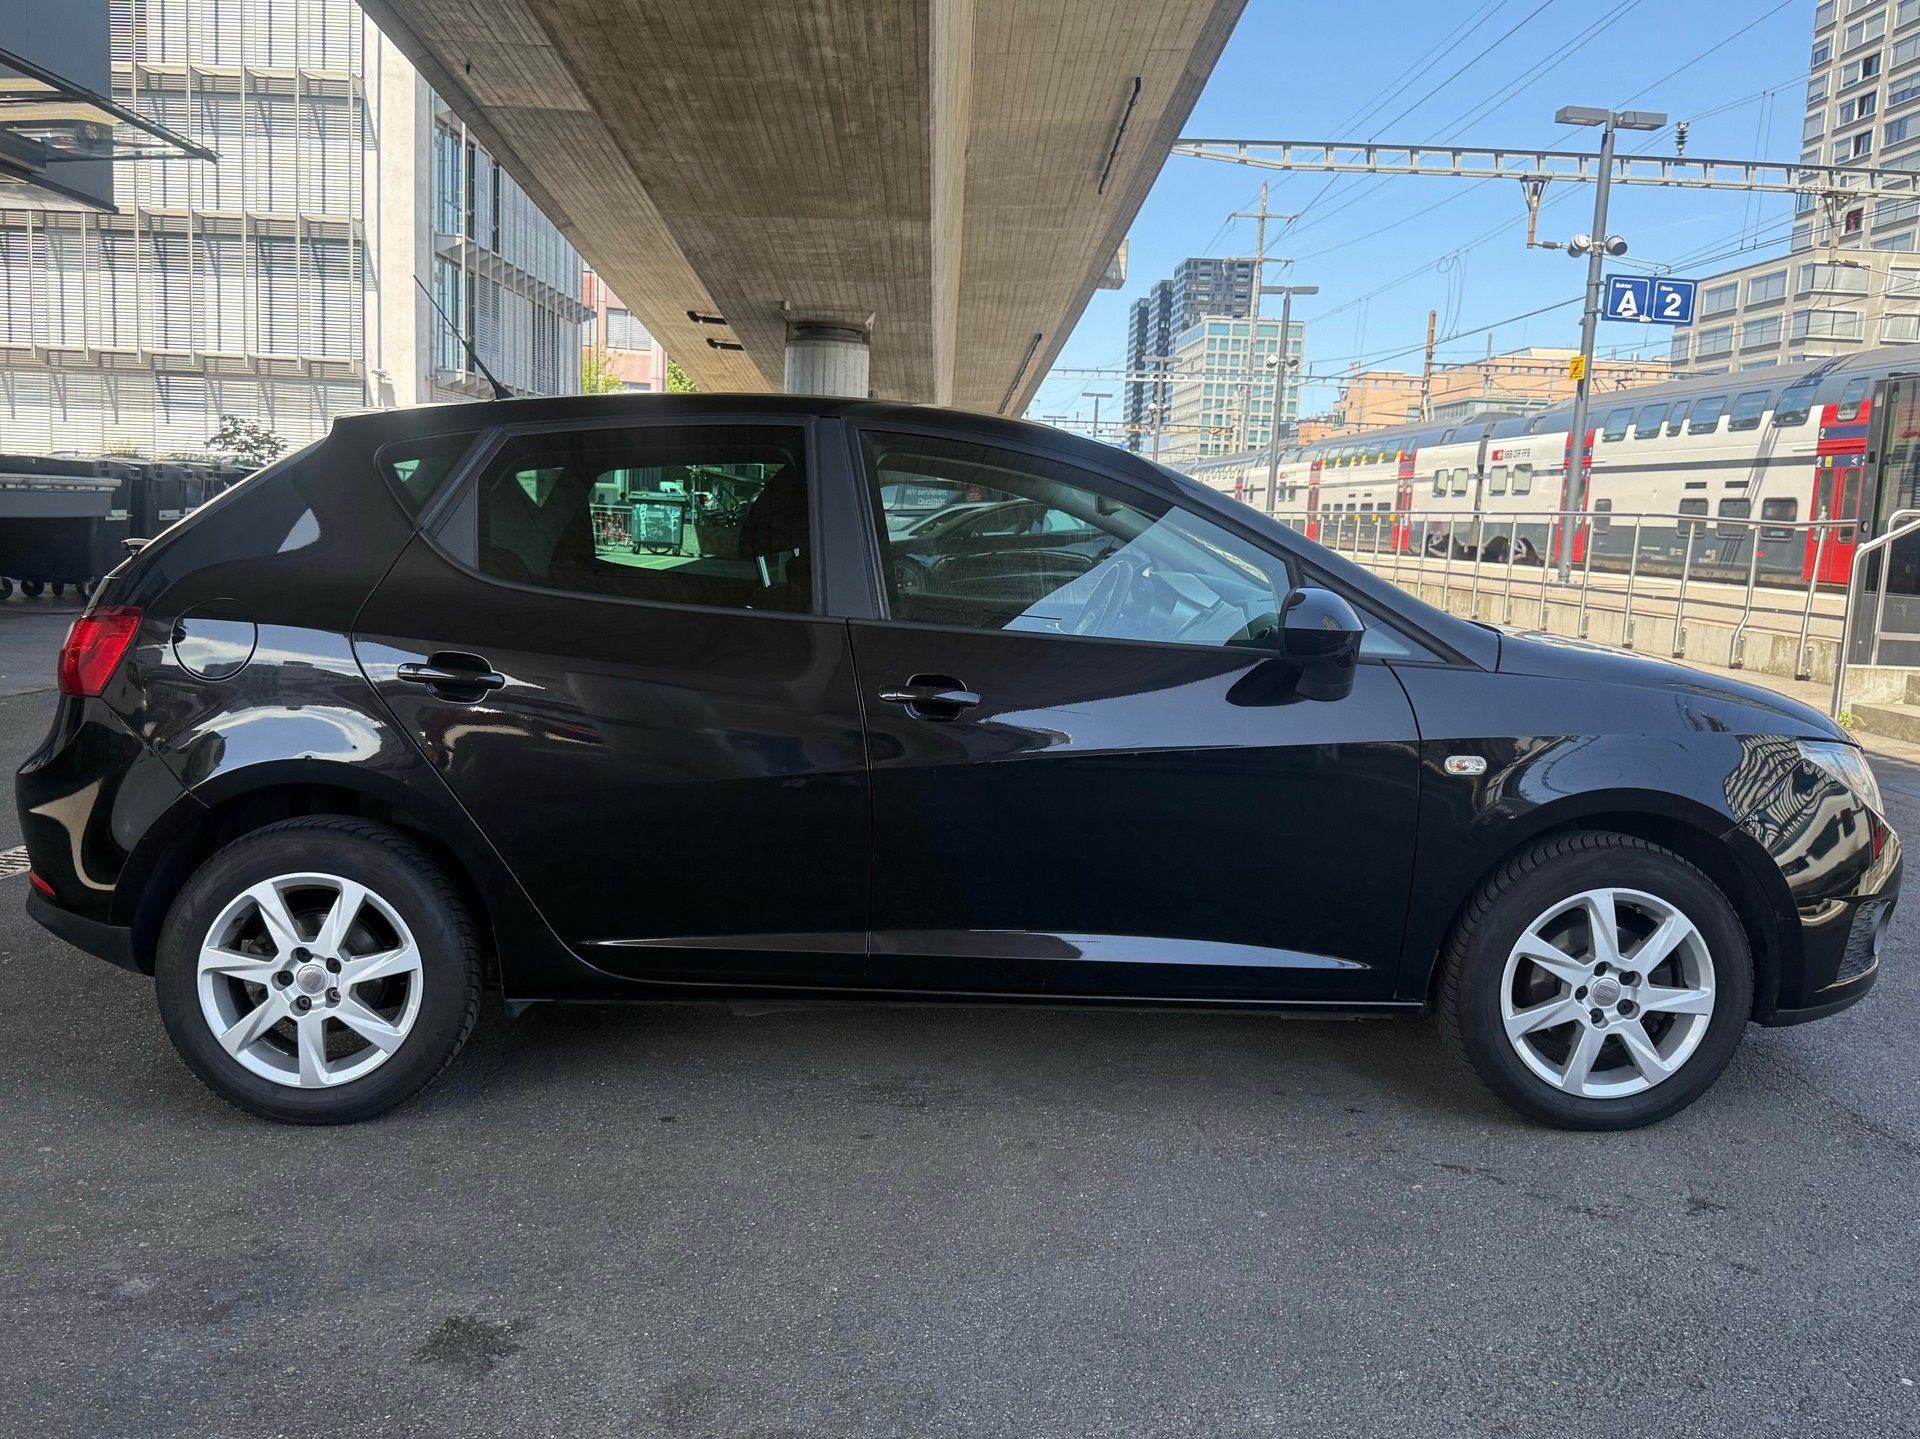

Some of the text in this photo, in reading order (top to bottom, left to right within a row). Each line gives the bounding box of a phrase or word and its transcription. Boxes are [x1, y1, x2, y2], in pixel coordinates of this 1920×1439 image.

[1616, 290, 1638, 314] A
[1663, 293, 1682, 317] 2
[1819, 428, 1826, 439] 2
[1504, 448, 1531, 459] SBB CFF FFS
[1816, 456, 1822, 468] 2
[905, 488, 916, 496] Wir
